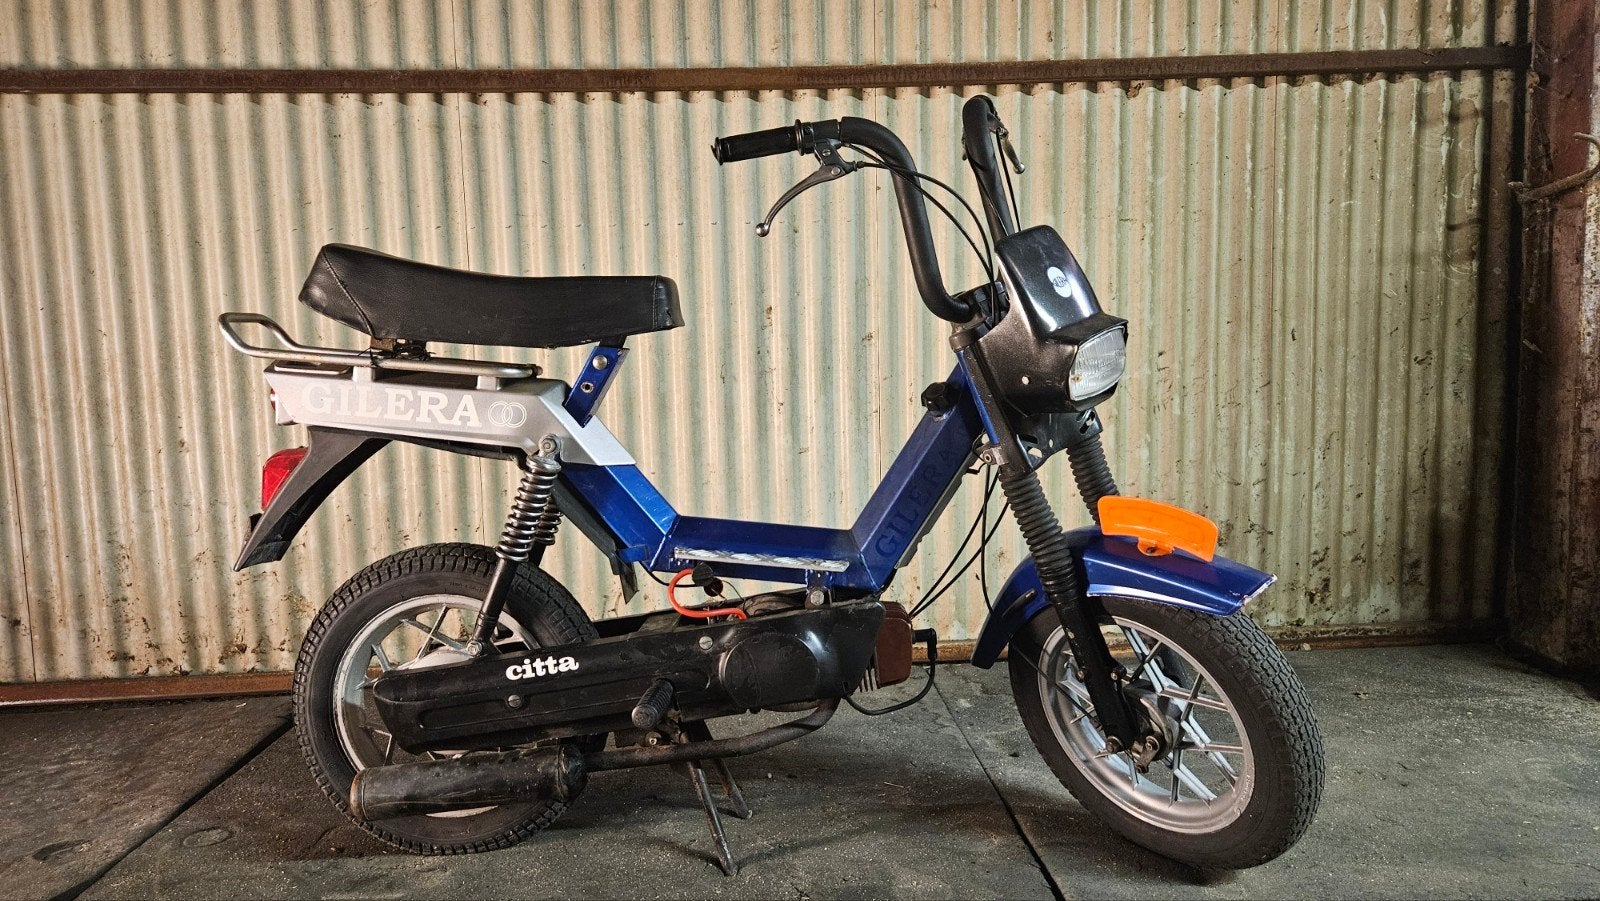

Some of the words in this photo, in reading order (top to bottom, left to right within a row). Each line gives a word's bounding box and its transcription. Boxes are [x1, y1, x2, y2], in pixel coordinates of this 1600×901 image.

[305, 383, 481, 427] GILERA
[875, 450, 958, 557] GILERA
[505, 655, 580, 681] citta
